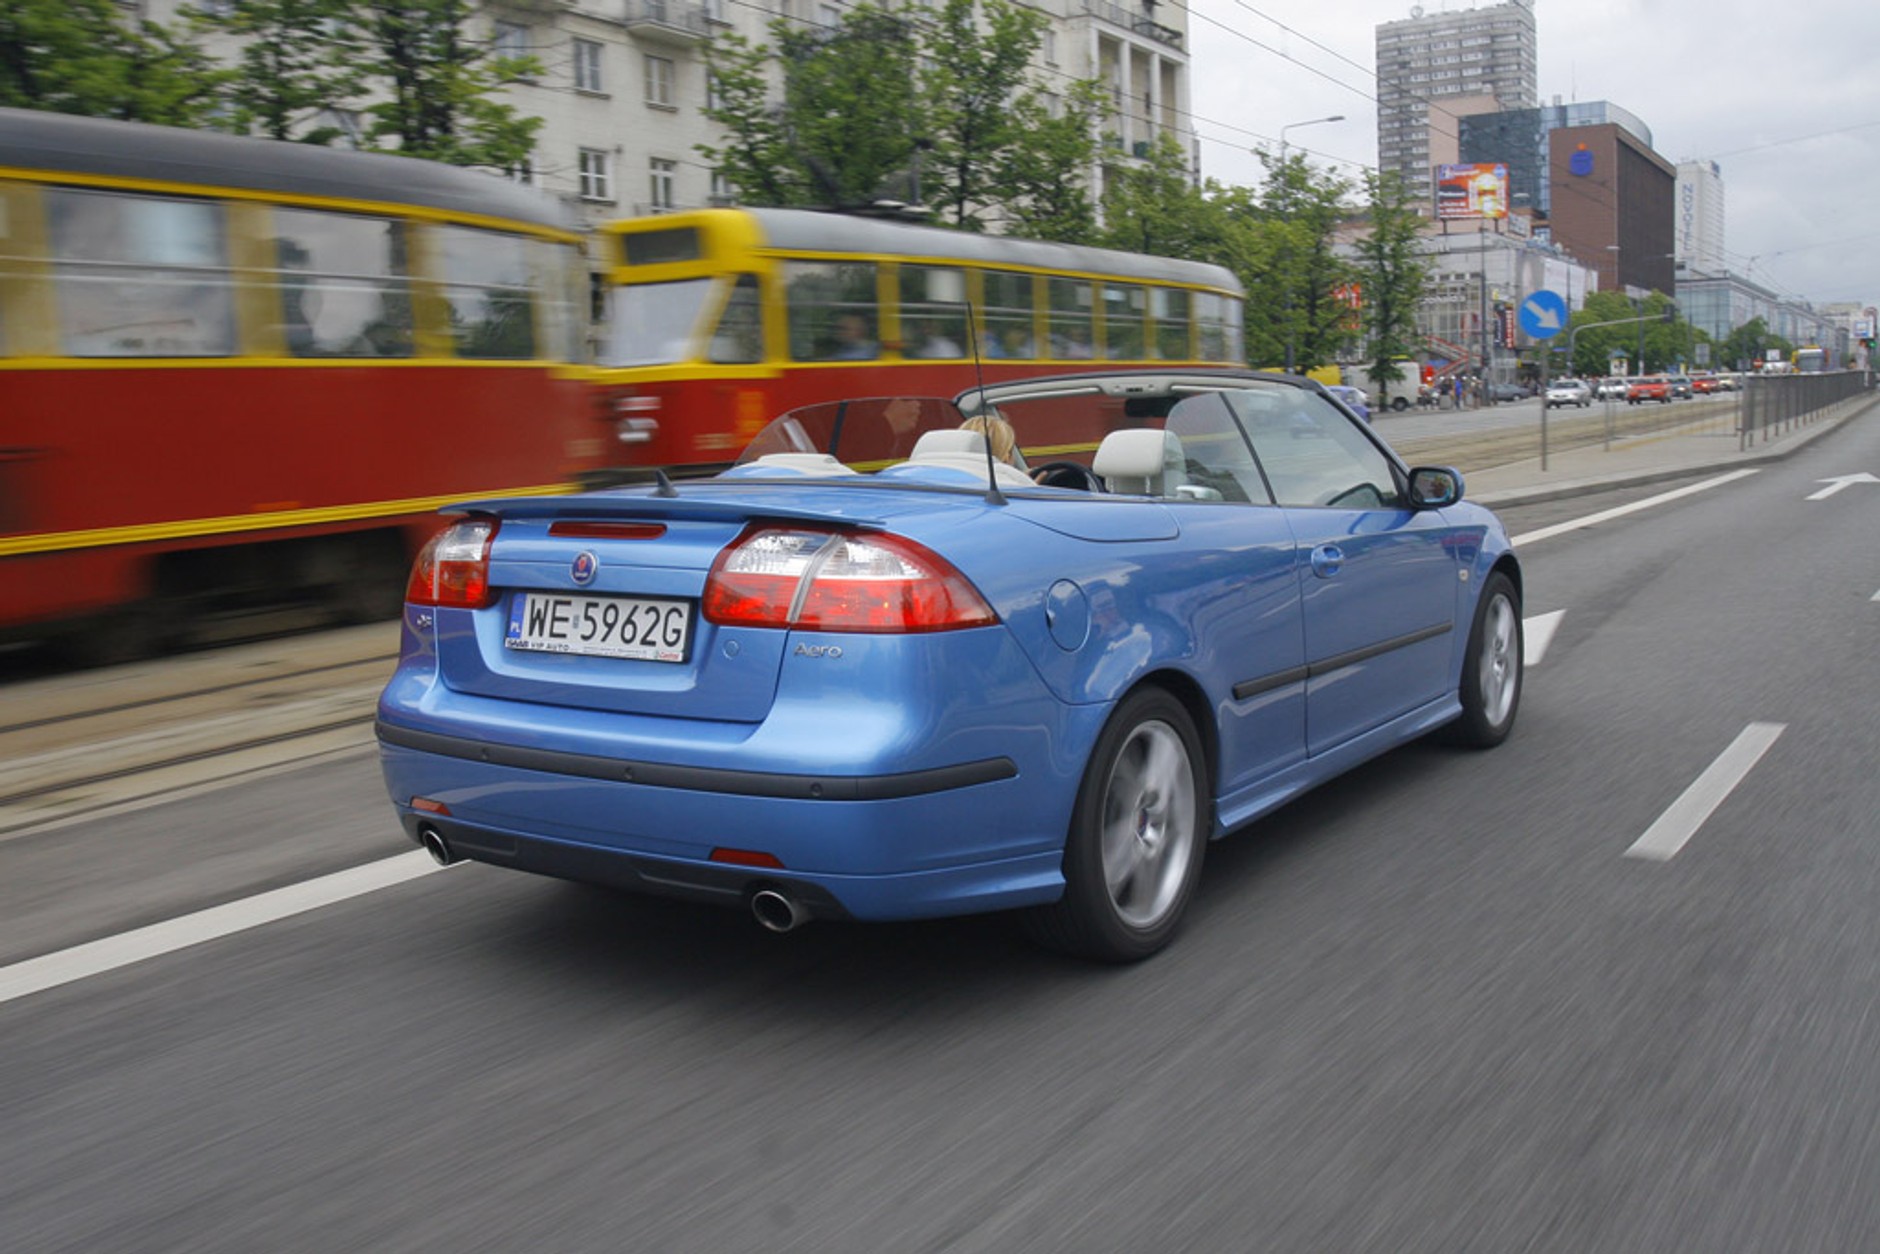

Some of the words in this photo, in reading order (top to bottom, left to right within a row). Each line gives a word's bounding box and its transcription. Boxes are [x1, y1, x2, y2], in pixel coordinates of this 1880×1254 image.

[510, 621, 521, 633] PL
[528, 598, 572, 639] WE
[580, 601, 684, 648] 5962G
[793, 642, 843, 659] Aero
